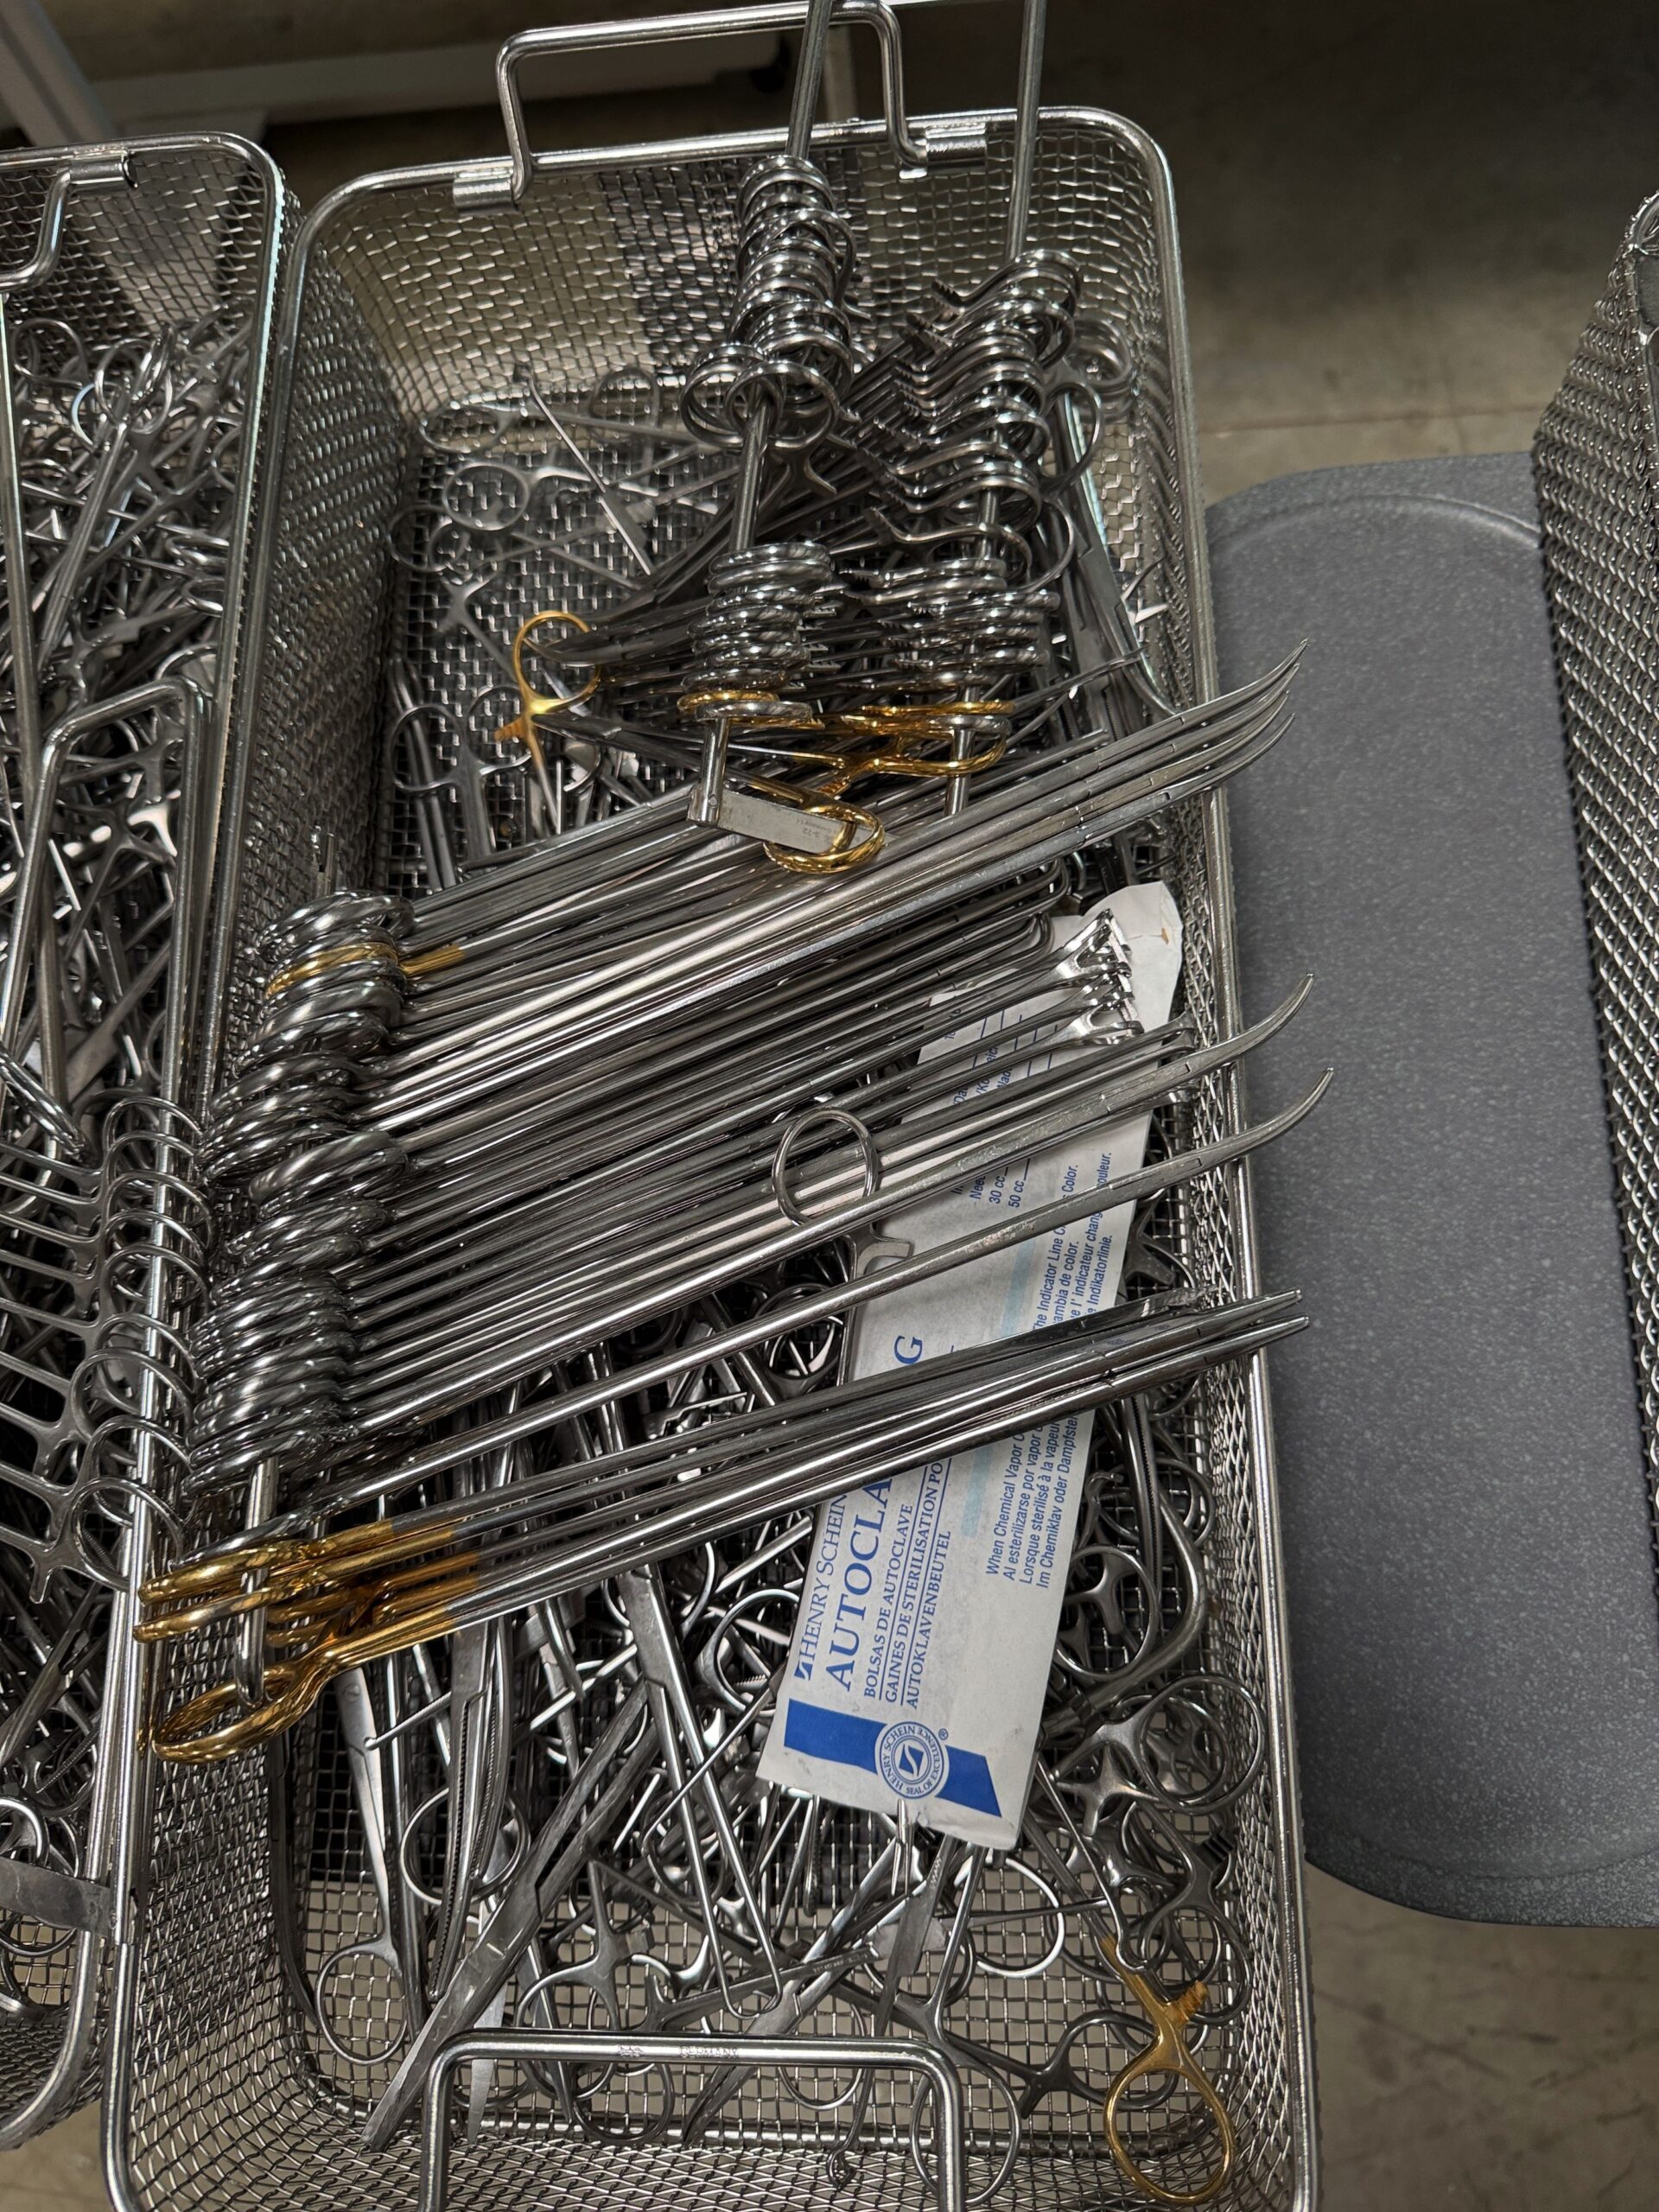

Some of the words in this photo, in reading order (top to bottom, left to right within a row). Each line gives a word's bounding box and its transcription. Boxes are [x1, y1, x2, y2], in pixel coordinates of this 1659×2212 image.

[989, 1190, 1001, 1204] 30
[995, 1175, 1006, 1189] cc
[1008, 1195, 1020, 1207] 50
[1014, 1179, 1025, 1193] cc
[1036, 1261, 1058, 1311] Indicator
[1048, 1237, 1064, 1261] Line
[1062, 1165, 1078, 1193] Color.
[1064, 1242, 1079, 1272] color.
[1075, 1243, 1094, 1297] indicateur
[1087, 1235, 1113, 1306] Indikatorlinie.
[1059, 1274, 1071, 1287] de
[1004, 1443, 1022, 1478] Vapor
[1027, 1433, 1041, 1466] vapor
[1040, 1461, 1053, 1472] la
[1023, 1469, 1035, 1491] por
[1038, 1474, 1052, 1483] à
[1054, 1476, 1068, 1503] oder
[994, 1481, 1015, 1537] Chemical
[1032, 1483, 1050, 1532] sterilisé
[1008, 1492, 1030, 1565] esterilizarse
[1039, 1506, 1064, 1568] Chemiklav
[883, 1503, 912, 1606] AUTOCLAVE
[902, 1486, 938, 1611] STERILISATION
[986, 1539, 1004, 1575] When
[1020, 1535, 1040, 1585] Lorsque
[799, 1577, 830, 1661] HENRY
[817, 1495, 848, 1576] SCHEIN
[1003, 1569, 1016, 1581] Al
[1036, 1572, 1052, 1588] Im
[877, 1608, 891, 1630] DE
[897, 1613, 912, 1637] DE
[906, 1529, 951, 1709] AUTOKLAVENBEUTEL
[864, 1635, 887, 1699] BOLSAS
[886, 1642, 906, 1704] GAINES
[884, 1725, 916, 1751] SCHEIN
[918, 1727, 940, 1780] EXCELLENCE
[883, 1754, 904, 1791] HENRY
[923, 1779, 933, 1789] OF
[906, 1786, 925, 1796] SEAL
